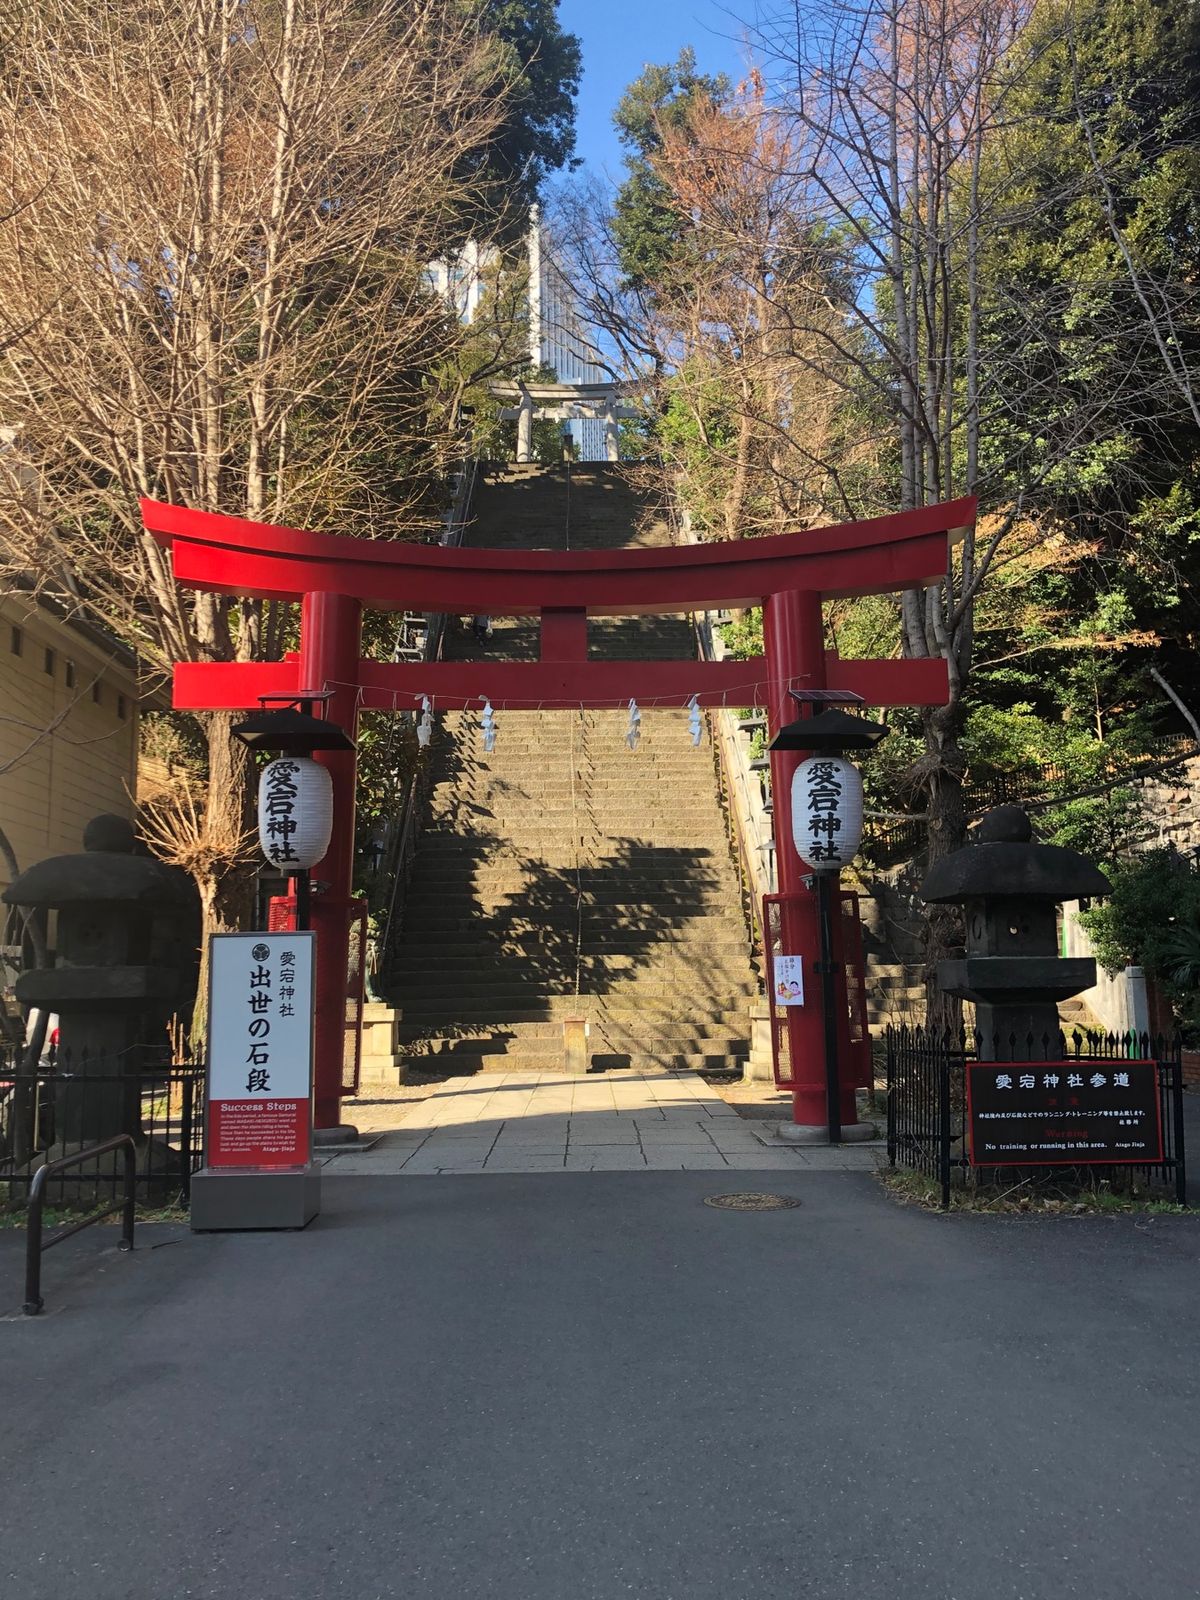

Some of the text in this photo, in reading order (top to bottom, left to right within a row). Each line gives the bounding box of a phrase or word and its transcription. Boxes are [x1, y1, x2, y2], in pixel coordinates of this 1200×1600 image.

[265, 761, 300, 863] 愛宕神社
[807, 761, 842, 861] 愛宕神社
[278, 951, 296, 1018] 愛宕神社
[245, 965, 273, 1092] 出世の石段
[221, 1102, 297, 1112] Success Steps
[995, 1072, 1131, 1089] 愛宕神社参道
